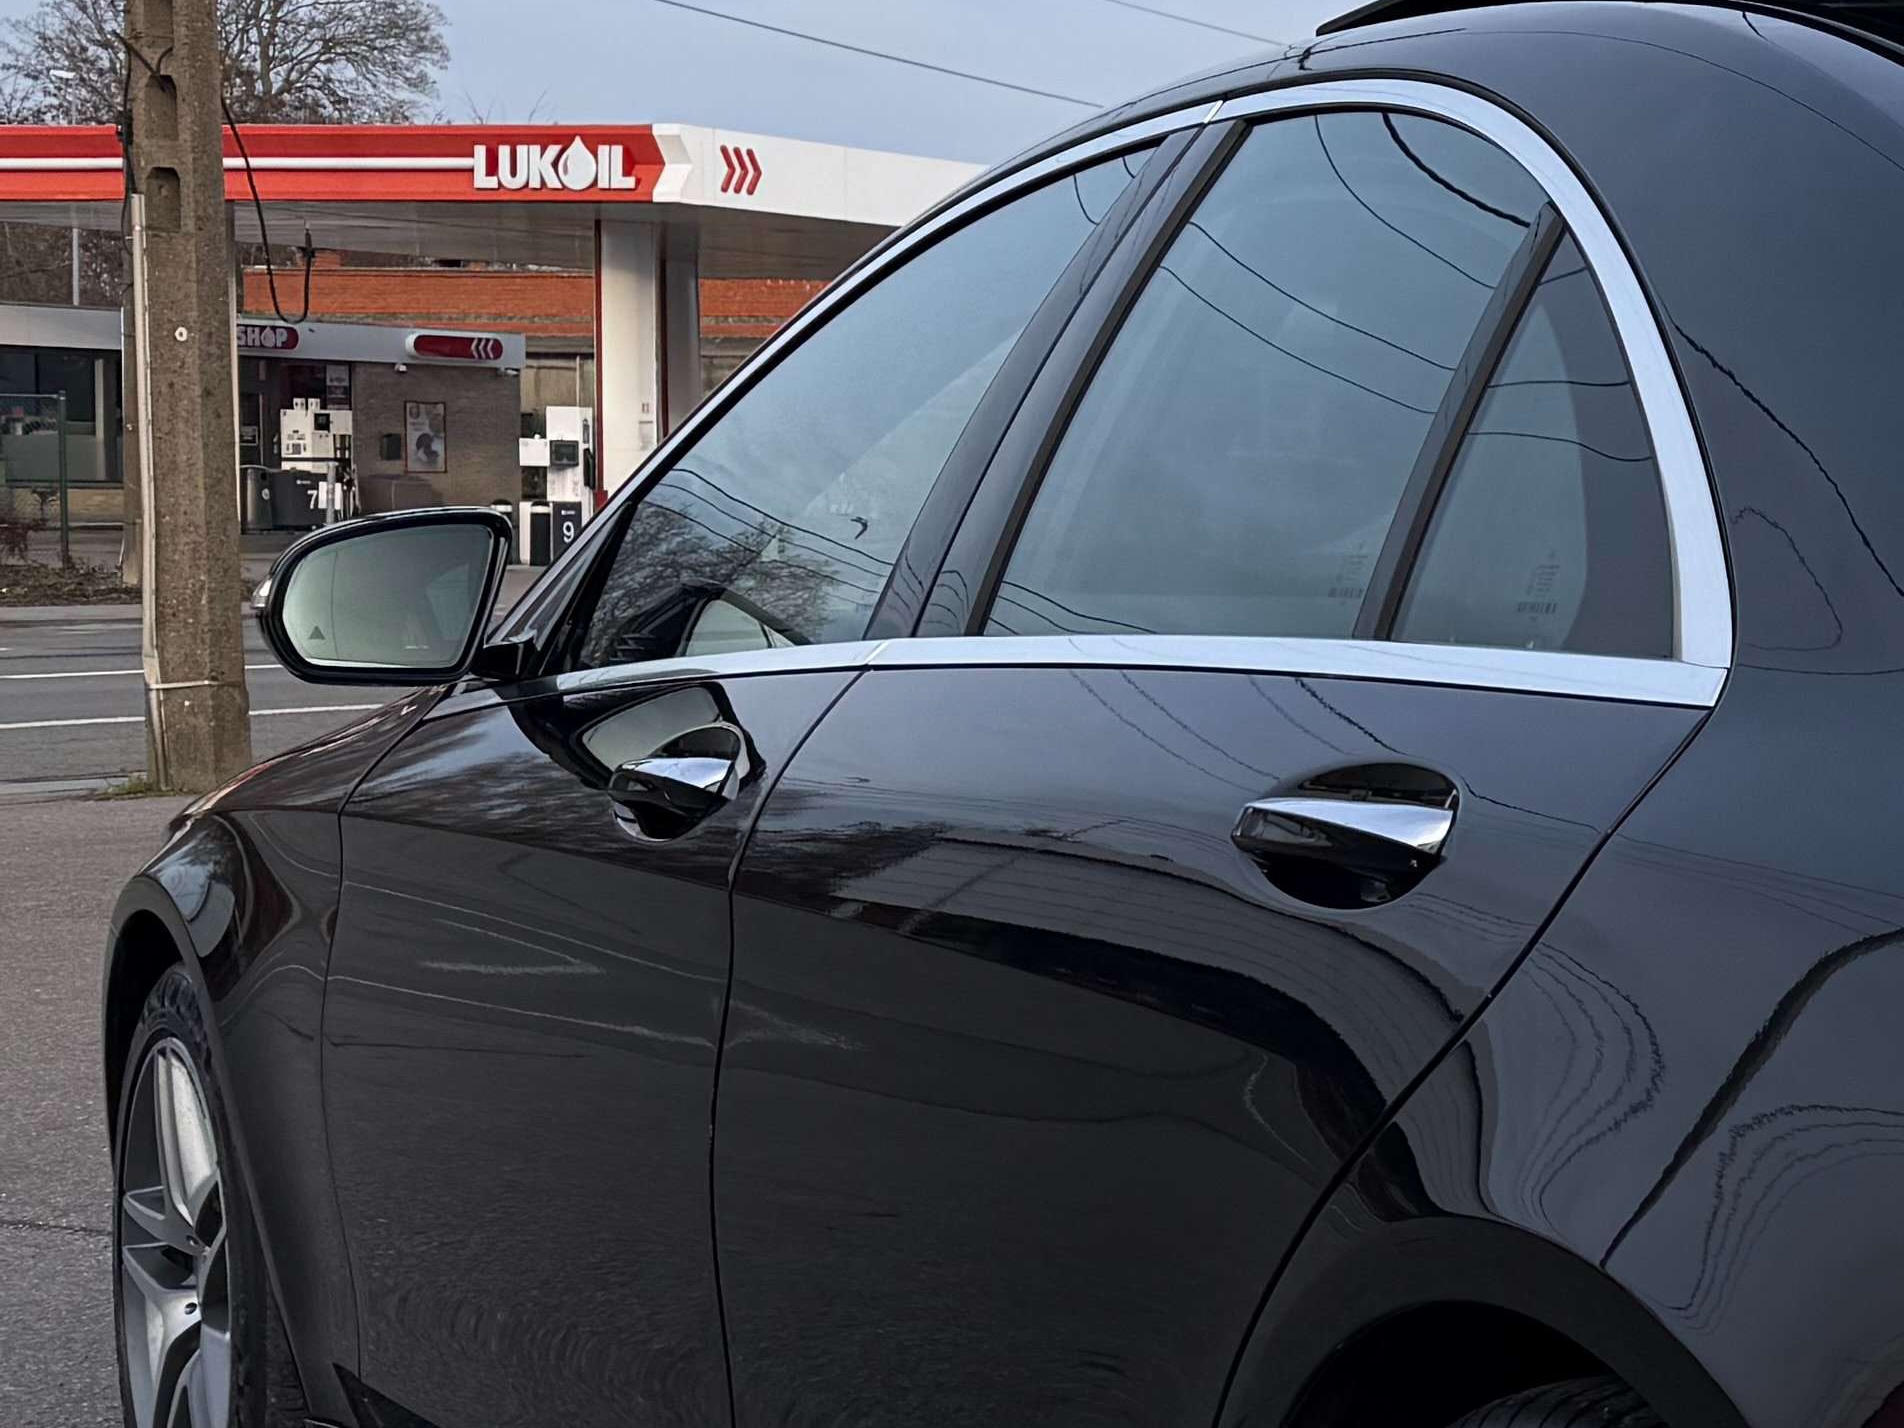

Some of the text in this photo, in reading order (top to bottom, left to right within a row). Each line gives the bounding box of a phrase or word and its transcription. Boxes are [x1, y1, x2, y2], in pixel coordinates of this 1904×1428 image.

[473, 135, 637, 191] LUKOIL
[236, 325, 288, 348] SHOP
[307, 489, 319, 510] 7
[562, 521, 575, 543] 9
